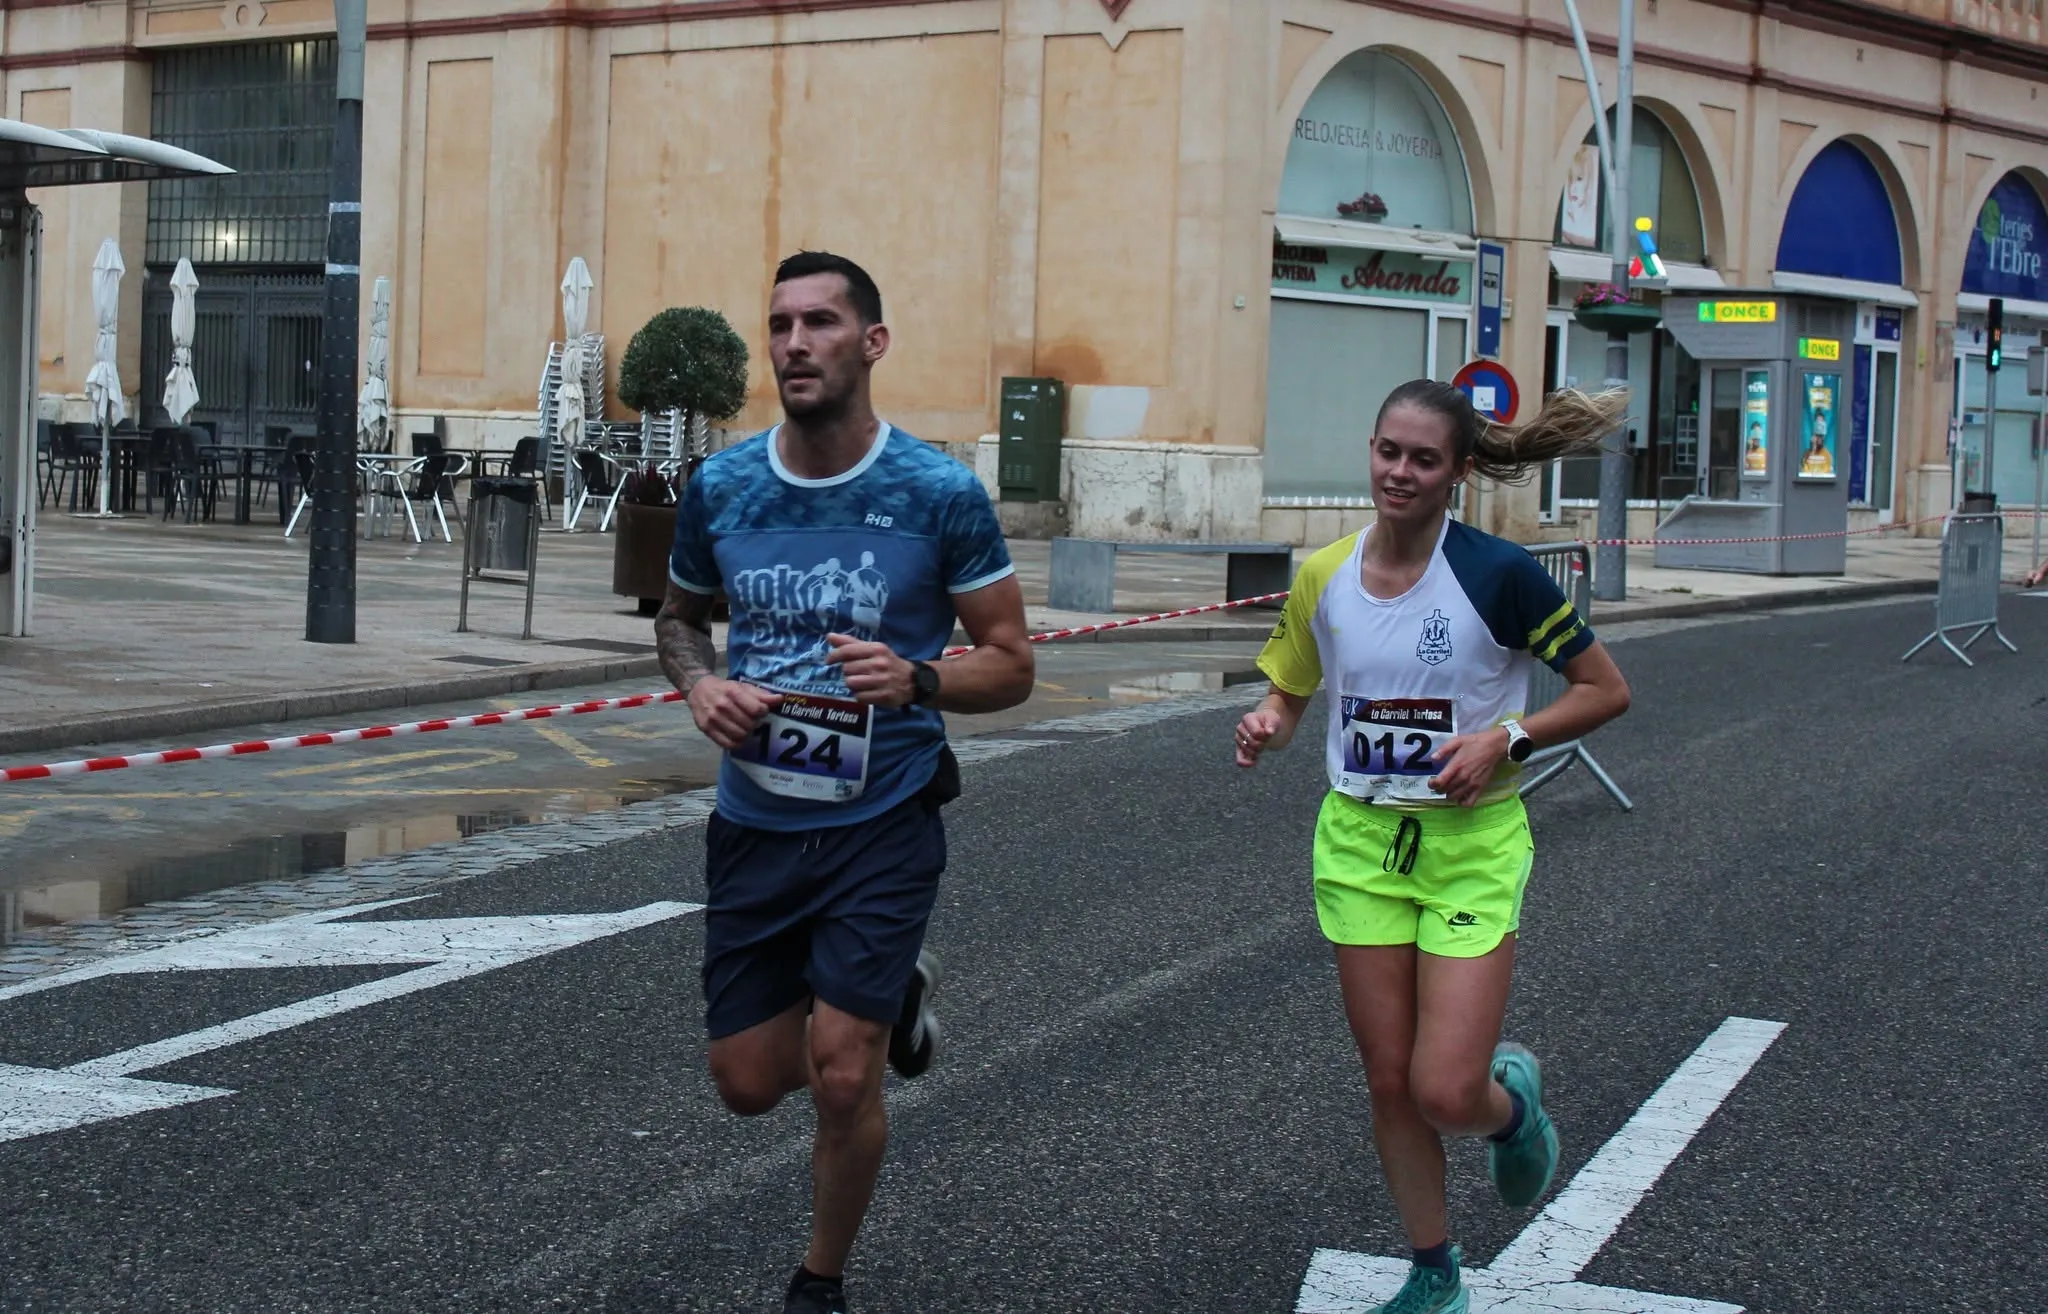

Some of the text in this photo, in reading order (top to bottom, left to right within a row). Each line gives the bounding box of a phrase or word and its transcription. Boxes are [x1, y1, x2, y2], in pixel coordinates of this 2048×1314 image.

[1294, 117, 1443, 160] RELOJERIA & JOYERIA
[1341, 250, 1461, 297] Aranda
[1721, 305, 1769, 318] ONCE
[1811, 343, 1837, 358] ONCE
[791, 703, 824, 720] Carrilet
[826, 708, 860, 724] Tortosa
[1380, 708, 1410, 720] Carrilet
[1413, 709, 1443, 720] Tortosa
[753, 722, 843, 772] 124
[1353, 731, 1433, 770] 012
